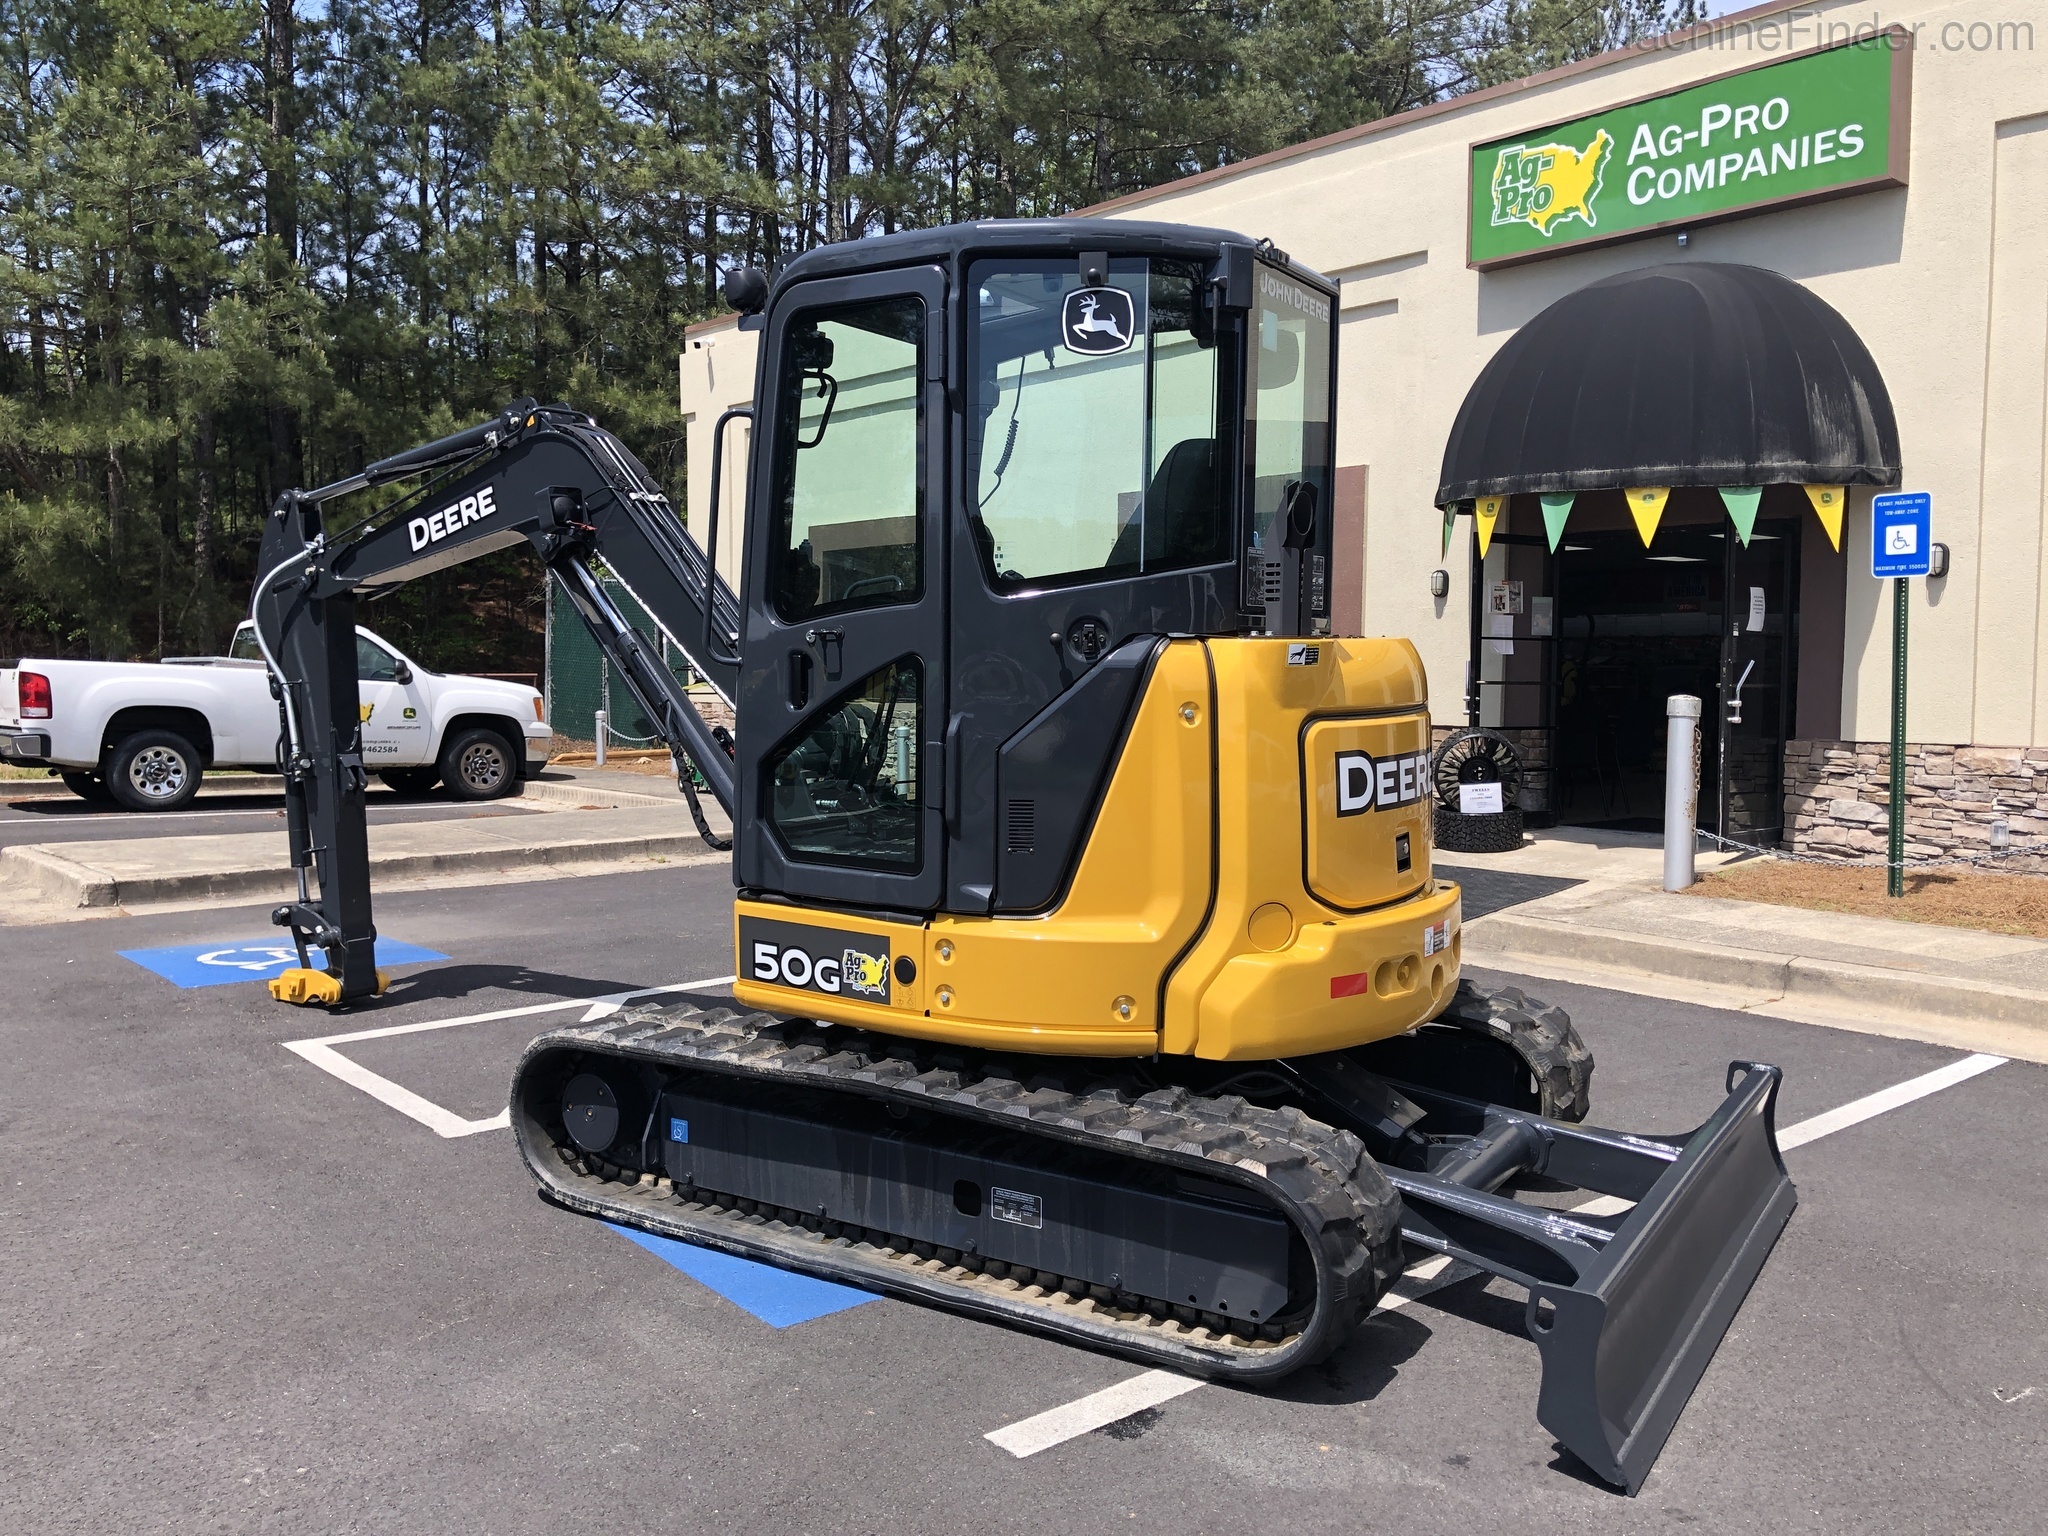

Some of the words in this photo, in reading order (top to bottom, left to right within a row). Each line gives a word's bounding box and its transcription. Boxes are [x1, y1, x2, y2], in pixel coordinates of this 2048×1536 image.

[1496, 149, 1554, 190] Ag-
[1494, 184, 1554, 222] Pro
[1260, 271, 1292, 306] JOHN
[1294, 287, 1329, 324] DEERE
[407, 485, 497, 552] DEERE
[1338, 752, 1433, 812] DEERE
[754, 942, 841, 993] 50G
[844, 952, 866, 969] Ag-
[845, 967, 867, 981] Pro
